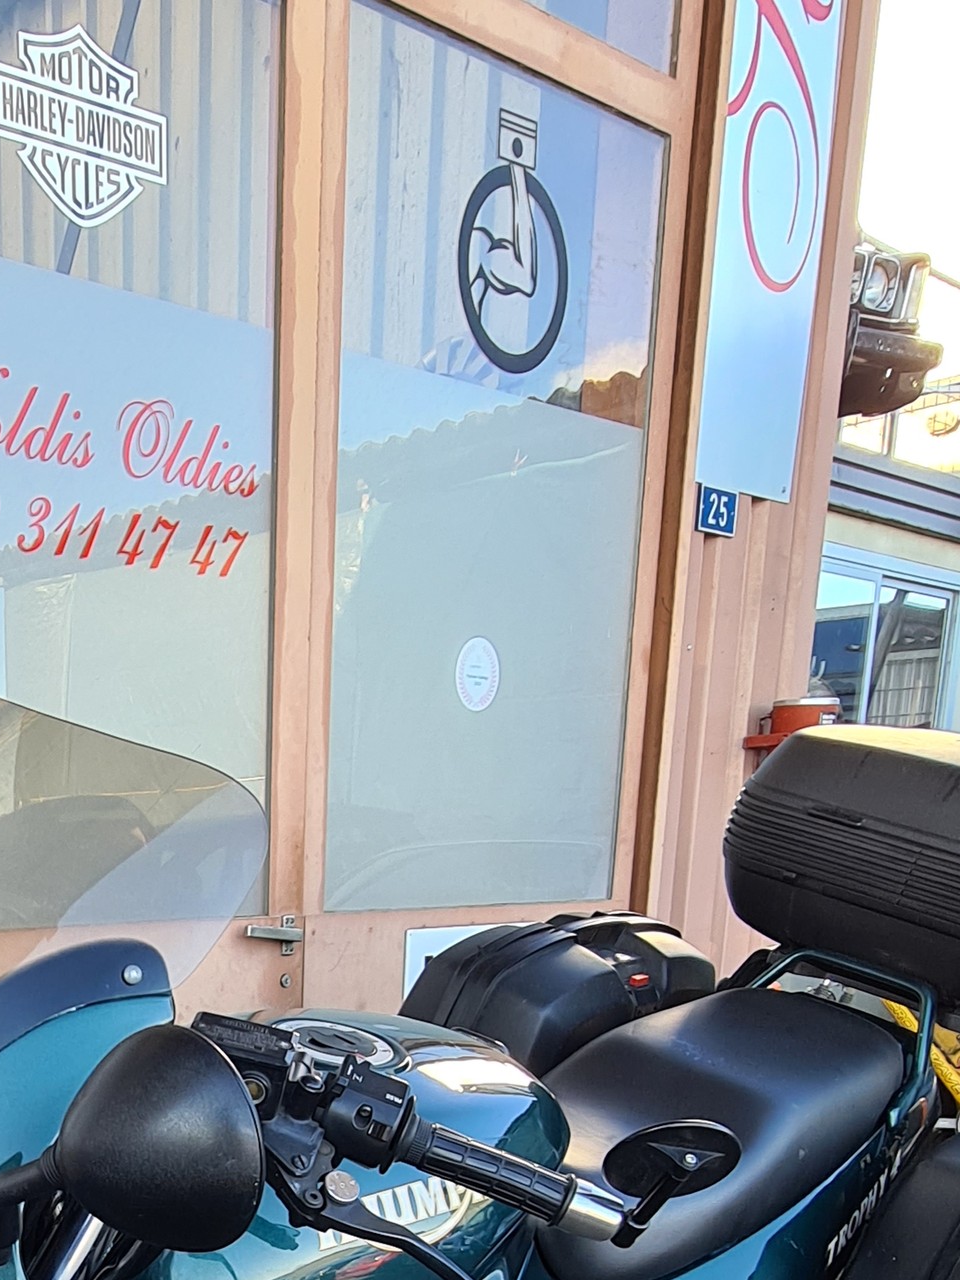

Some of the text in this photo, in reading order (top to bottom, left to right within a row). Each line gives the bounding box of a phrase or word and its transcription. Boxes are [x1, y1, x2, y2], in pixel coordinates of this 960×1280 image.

[40, 46, 120, 102] MOTOR
[2, 81, 155, 164] HARLEY-DAVIDSON
[41, 148, 121, 210] CYCLES
[116, 400, 259, 497] Oldies
[17, 497, 105, 559] 311
[116, 514, 180, 569] 47
[190, 525, 249, 577] 47
[707, 492, 729, 527] 25
[825, 1167, 888, 1267] TROPHY
